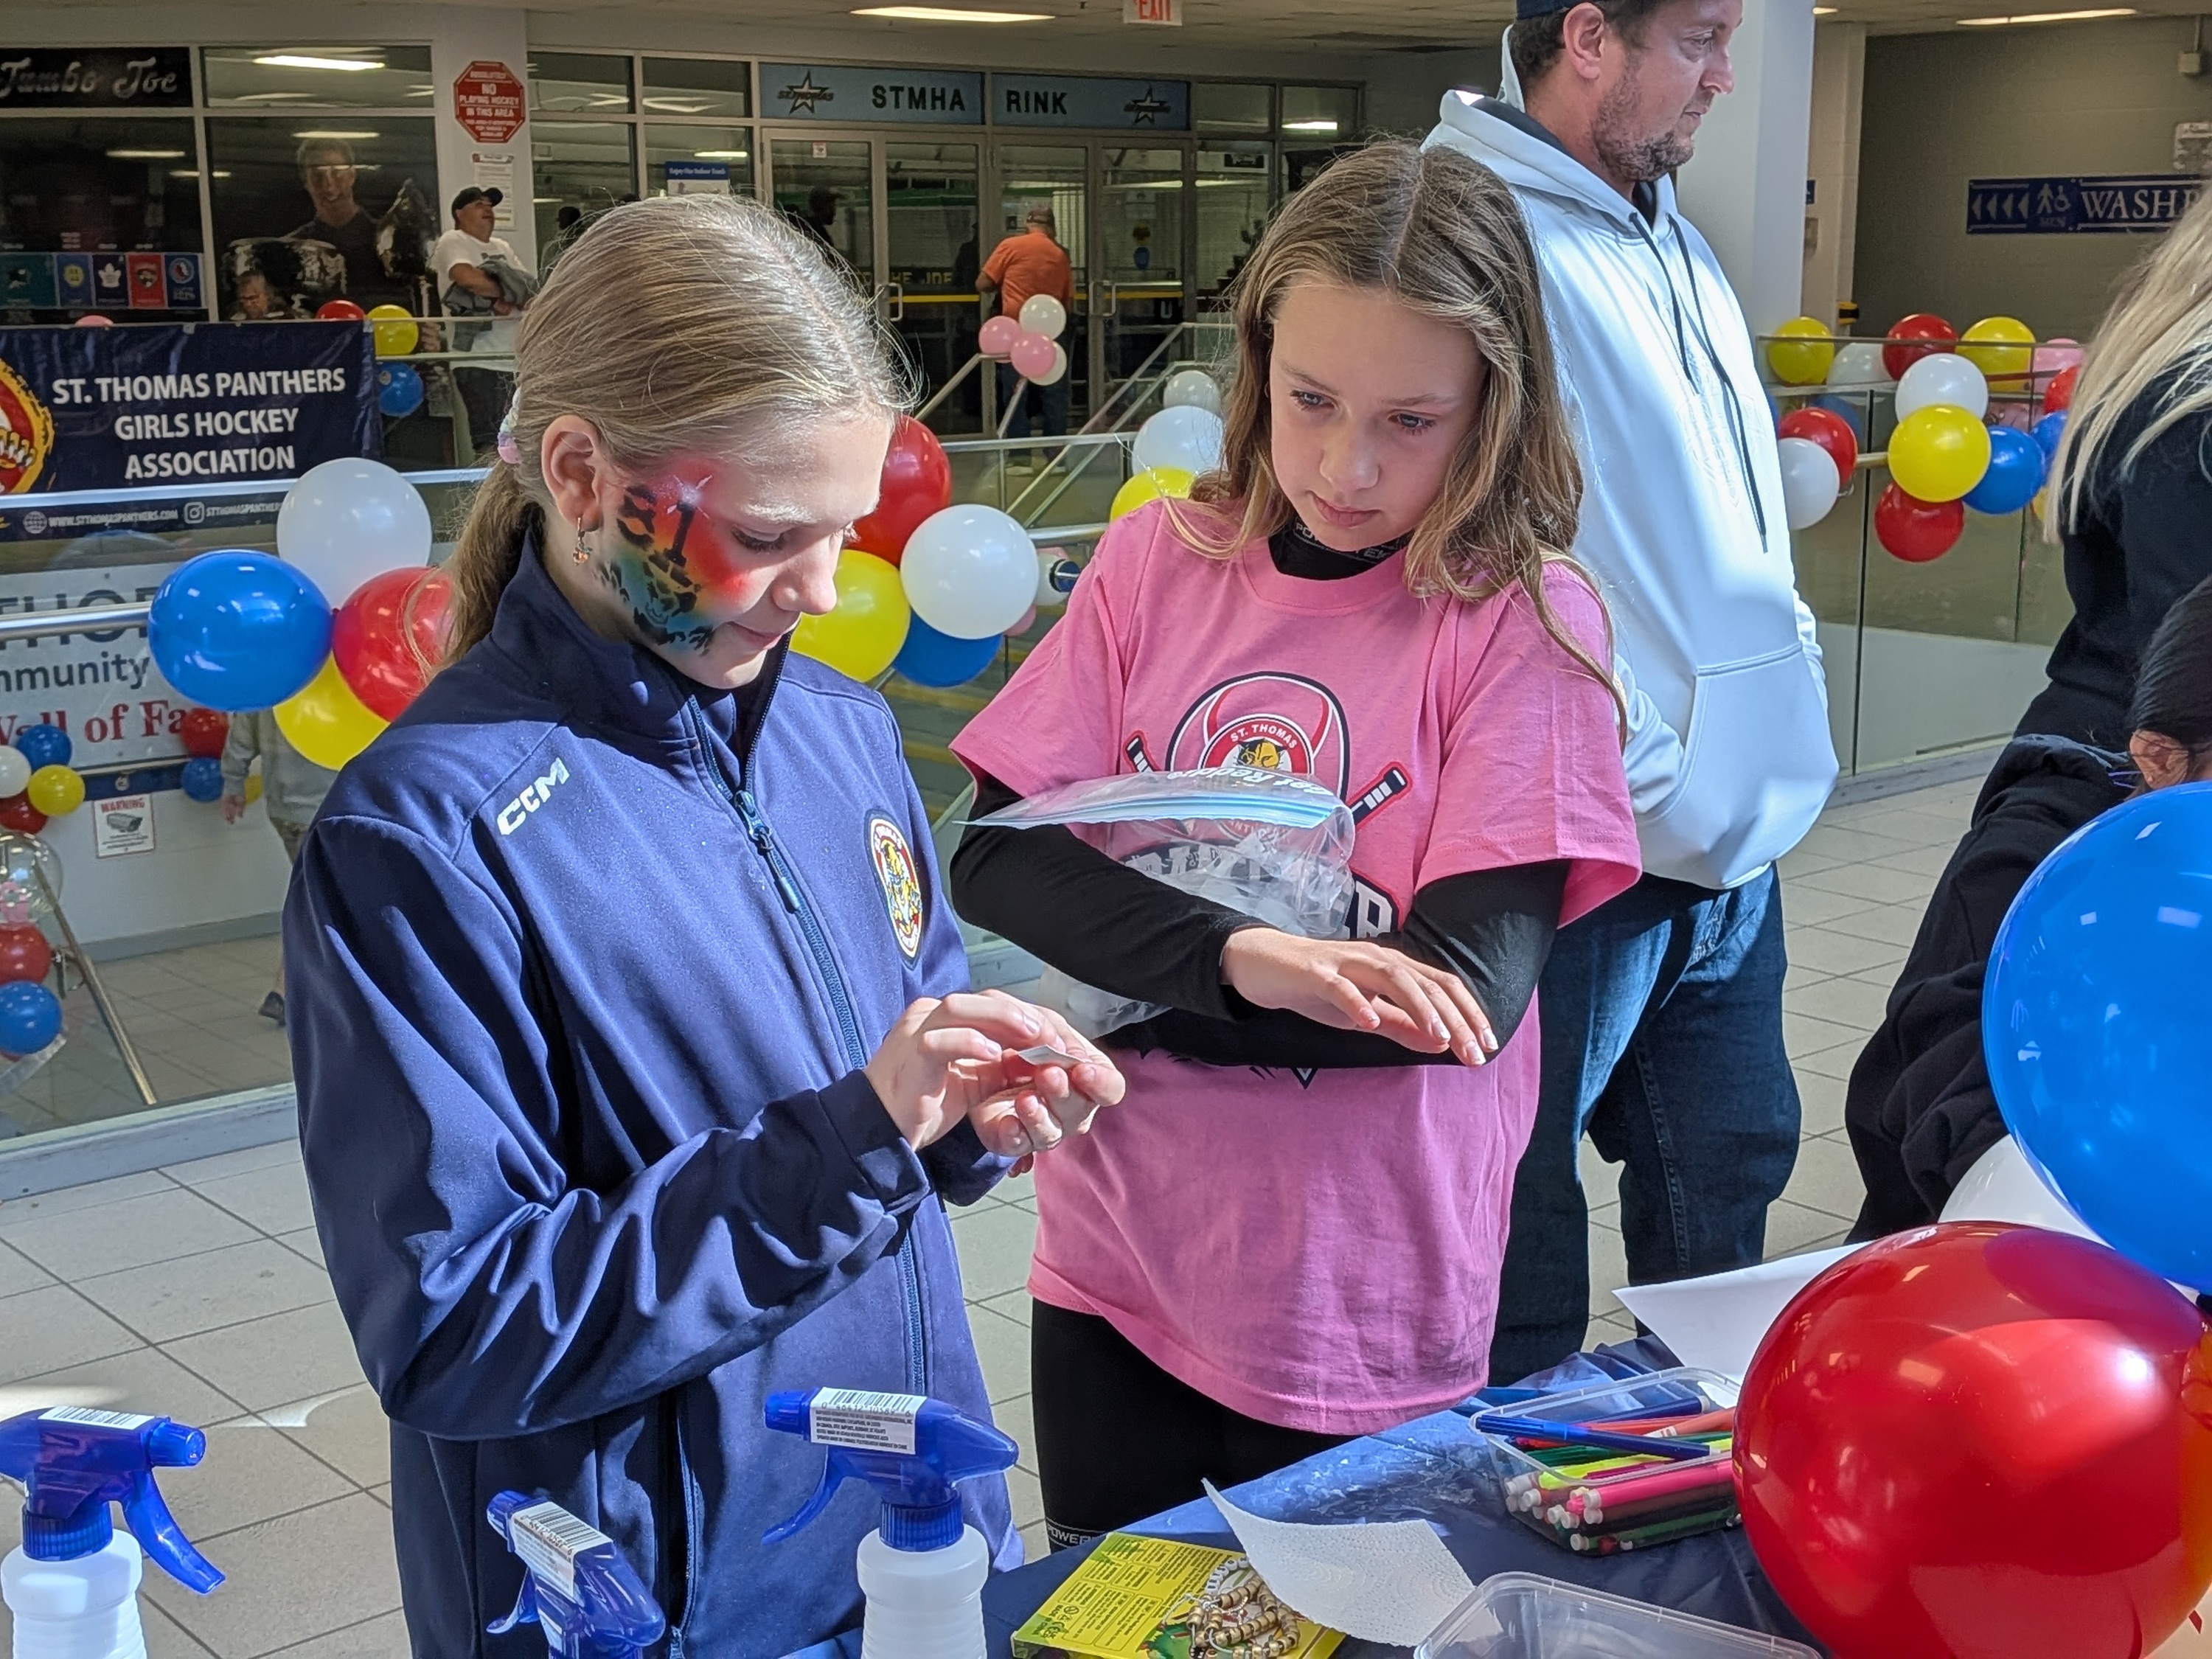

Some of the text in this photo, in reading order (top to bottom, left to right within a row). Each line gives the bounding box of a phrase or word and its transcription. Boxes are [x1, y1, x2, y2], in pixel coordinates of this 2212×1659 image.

[112, 57, 178, 99] Joe
[481, 83, 497, 95] NO
[872, 84, 1067, 114] STMHA RINK
[52, 368, 346, 404] ST. THOMAS PANTHERS
[114, 408, 299, 440] GIRLS HOCKEY
[125, 445, 296, 480] ASSOCIATION
[84, 703, 129, 743] of
[1230, 724, 1298, 749] ST. THOMAS
[101, 799, 145, 813] WARNING
[497, 757, 570, 835] CCM
